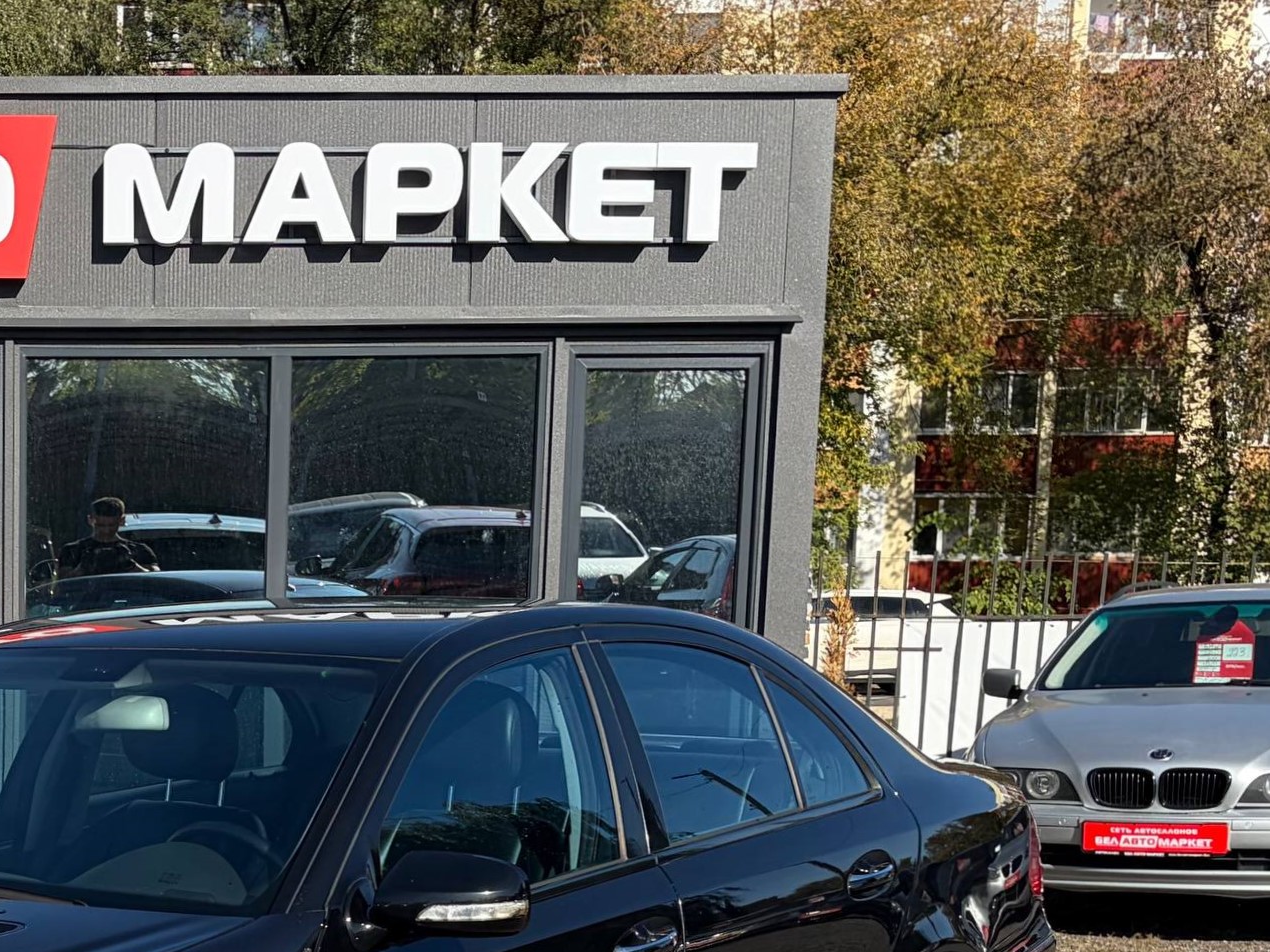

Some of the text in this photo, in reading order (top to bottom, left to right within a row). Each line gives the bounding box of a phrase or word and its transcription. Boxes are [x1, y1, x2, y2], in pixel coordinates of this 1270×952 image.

[102, 141, 758, 246] МАРКЕТ
[1110, 826, 1198, 835] СЕТЬ АВТОСАЛОНОВ
[1095, 836, 1213, 847] БЕЛ АВТО МАРКЕТ
